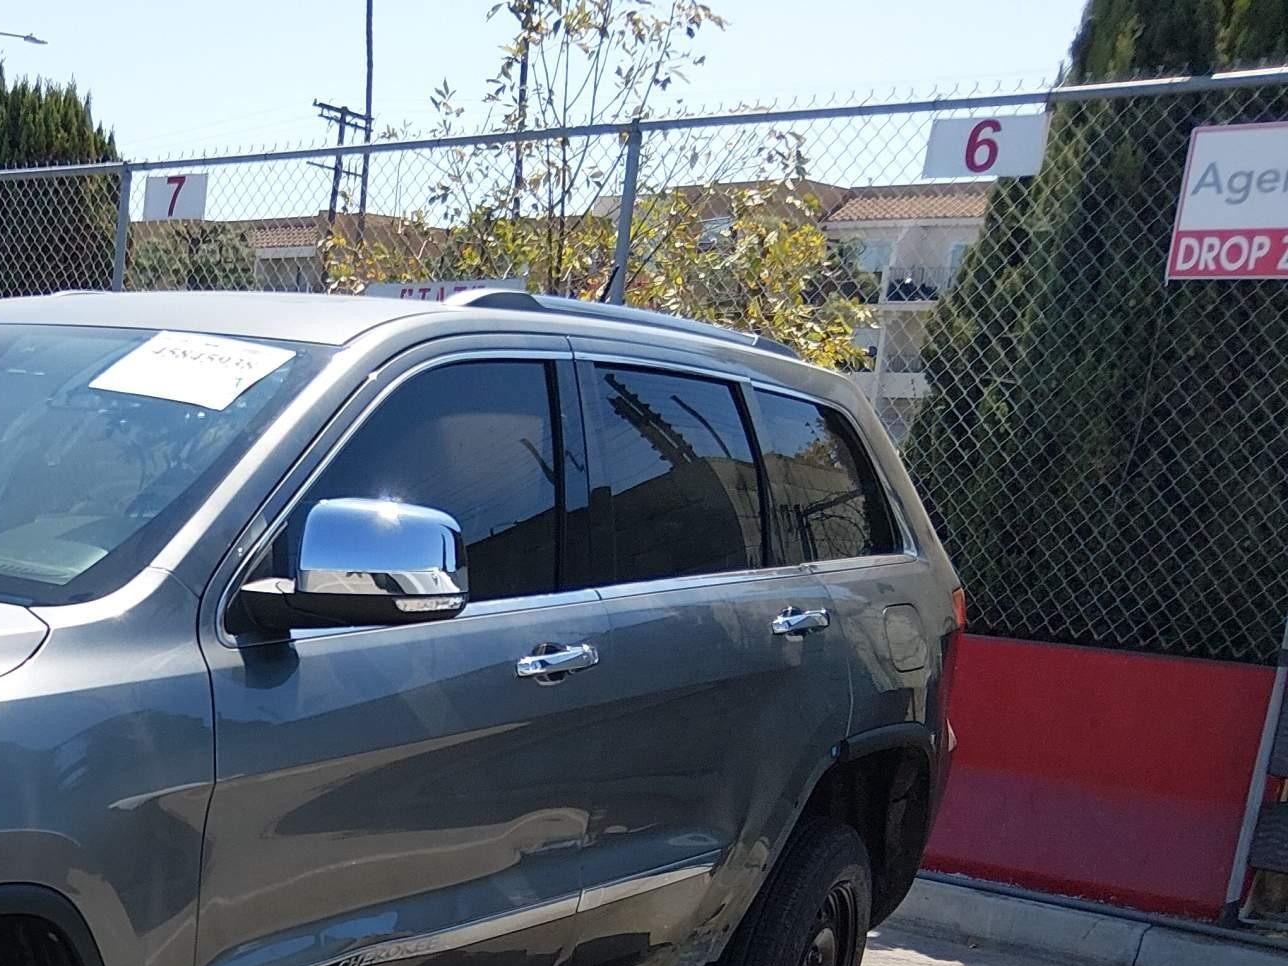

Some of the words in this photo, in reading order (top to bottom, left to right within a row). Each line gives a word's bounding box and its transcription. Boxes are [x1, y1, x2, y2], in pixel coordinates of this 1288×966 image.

[965, 118, 1002, 173] 6
[167, 175, 186, 217] 7
[1191, 160, 1288, 205] Age
[1175, 235, 1271, 271] DROP
